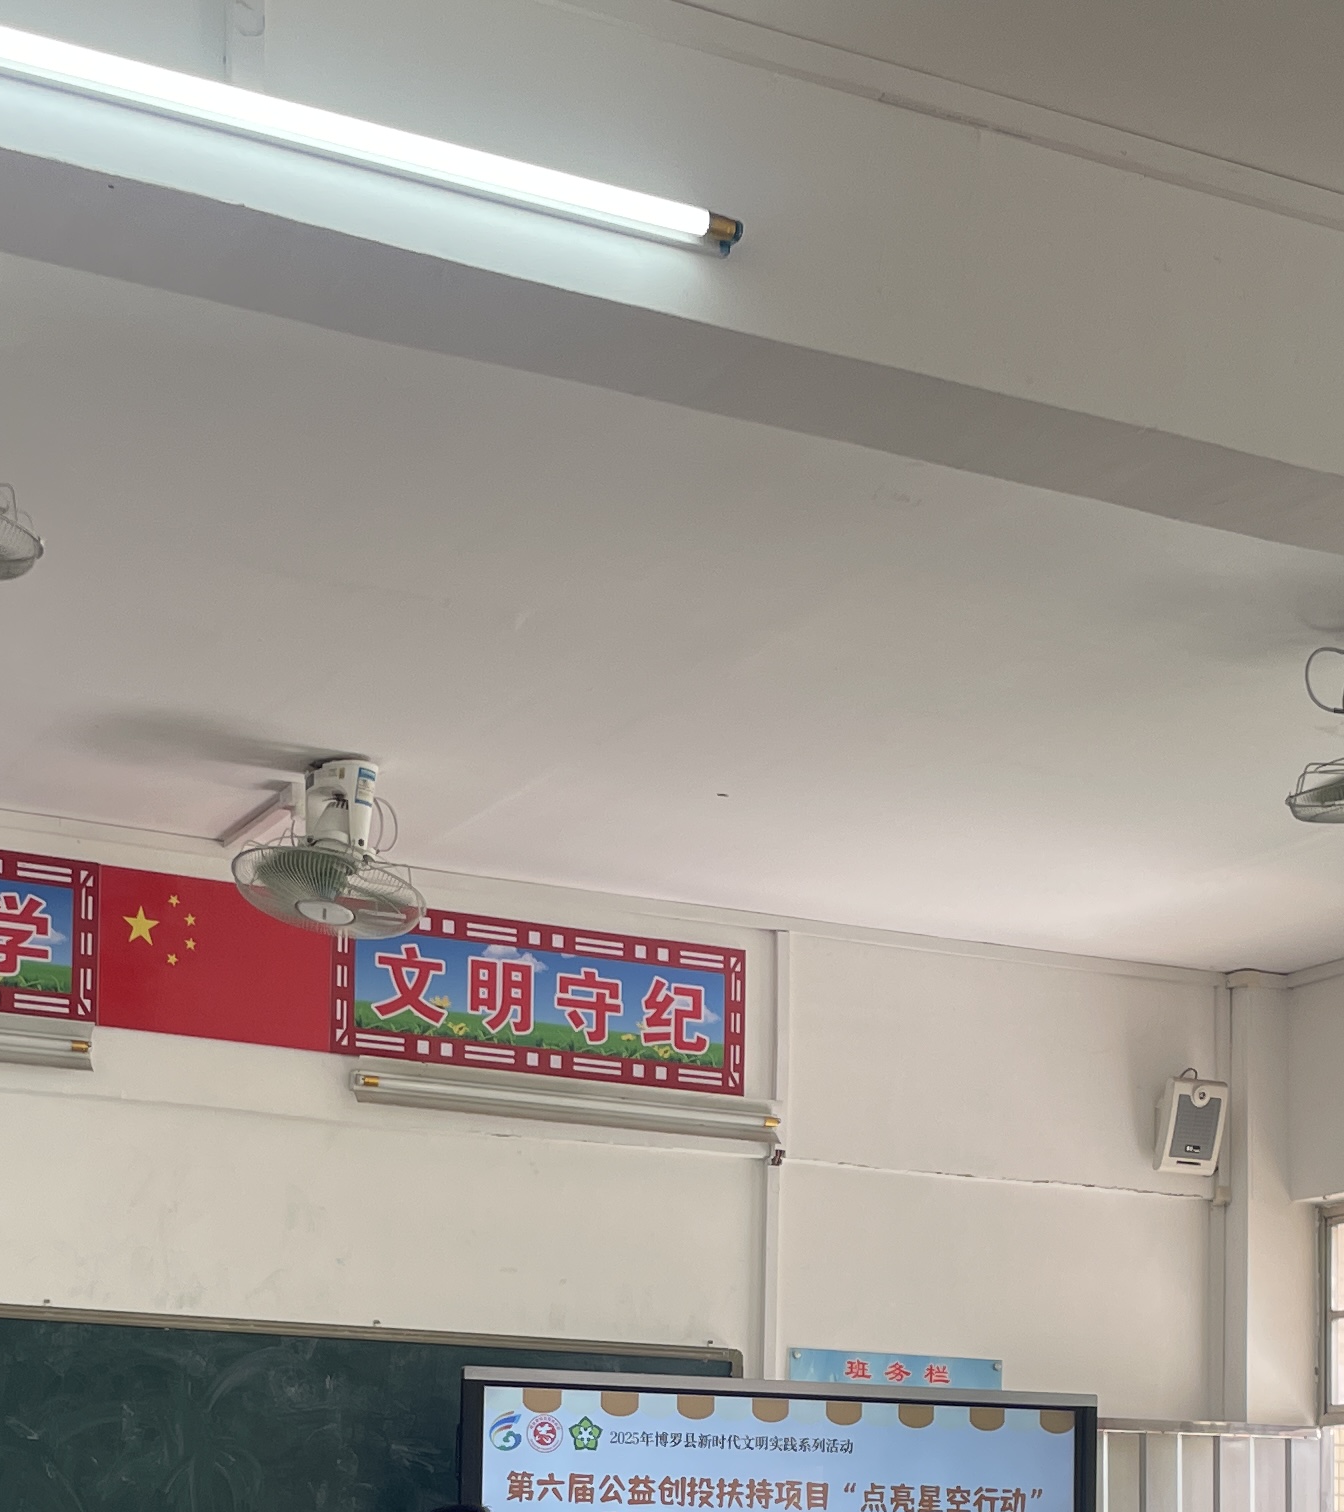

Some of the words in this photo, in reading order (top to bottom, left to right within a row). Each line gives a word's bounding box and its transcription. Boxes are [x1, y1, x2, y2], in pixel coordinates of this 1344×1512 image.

[371, 942, 711, 1056] 文明守纪
[844, 1359, 951, 1385] 班务栏
[609, 1430, 854, 1454] 2025年博罗县新时代文明实践系列活动
